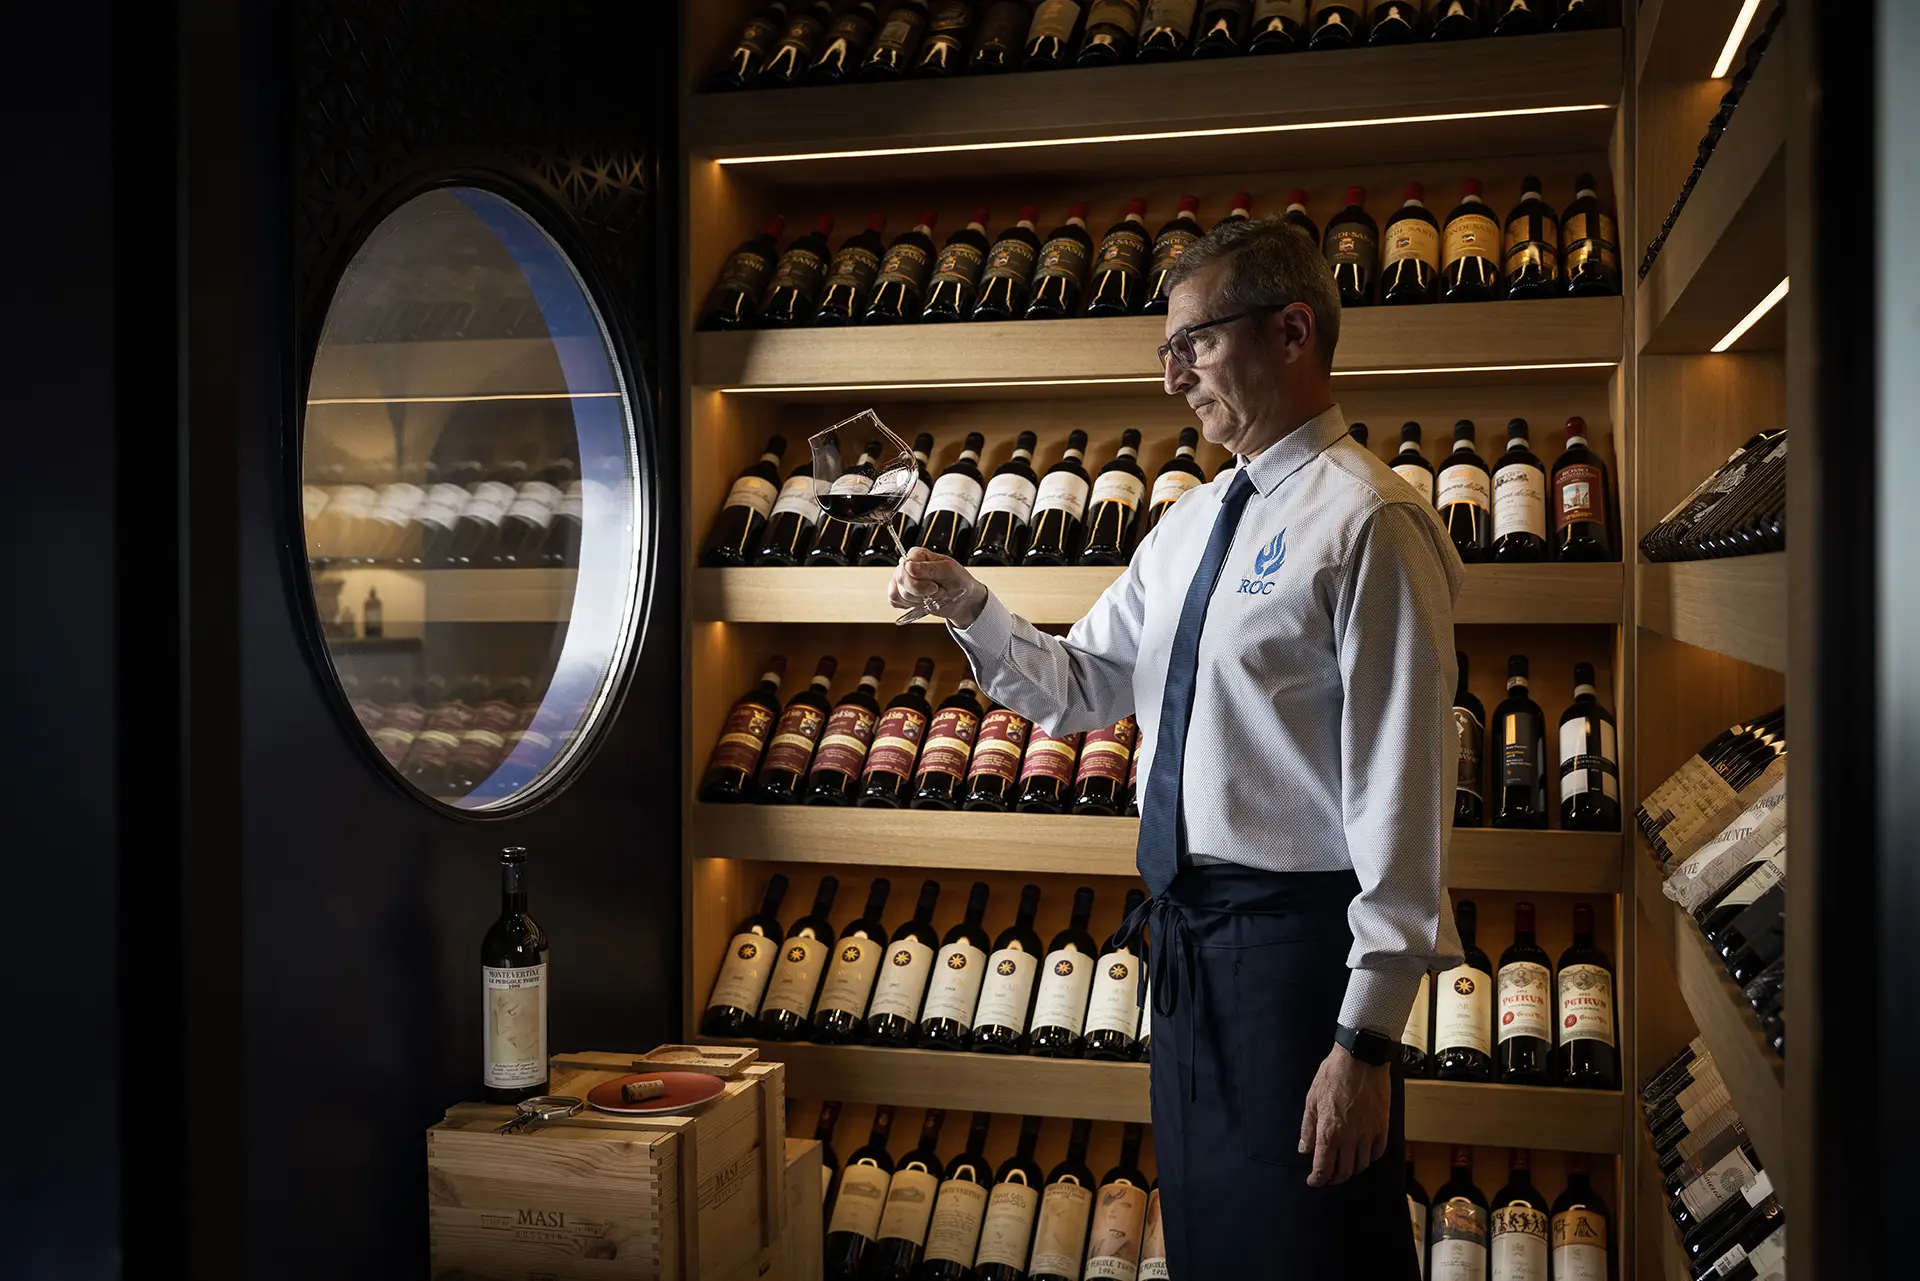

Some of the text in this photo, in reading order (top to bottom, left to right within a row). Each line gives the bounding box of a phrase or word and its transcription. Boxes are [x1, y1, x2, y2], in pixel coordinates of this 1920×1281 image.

[1237, 578, 1276, 596] ROC
[489, 969, 540, 978] MONTEVERTINE
[1503, 994, 1544, 1007] PETRUS
[1564, 997, 1607, 1009] PETRUS
[715, 1160, 740, 1192] MASI
[518, 1208, 565, 1228] MASI
